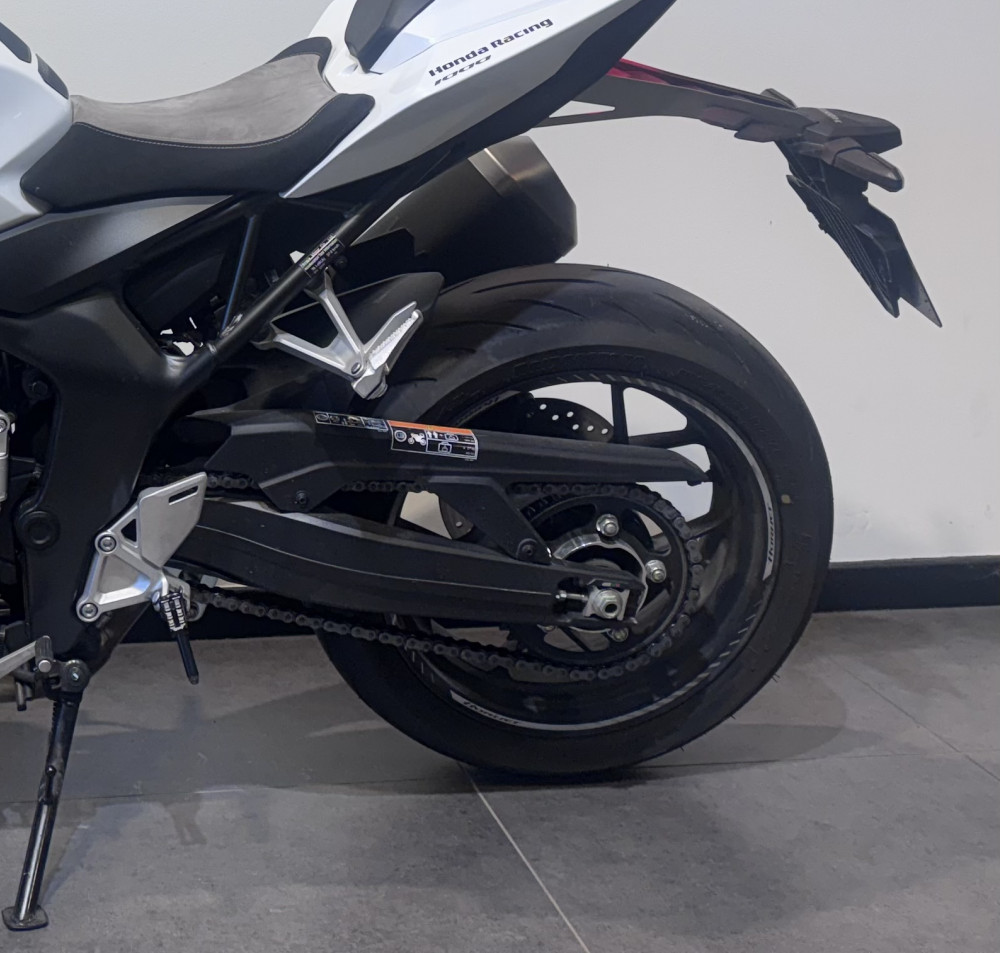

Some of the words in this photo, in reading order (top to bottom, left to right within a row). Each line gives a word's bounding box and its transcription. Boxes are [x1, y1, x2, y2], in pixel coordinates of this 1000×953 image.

[428, 46, 490, 77] Honda
[490, 18, 554, 48] Racing
[434, 54, 492, 86] 1000
